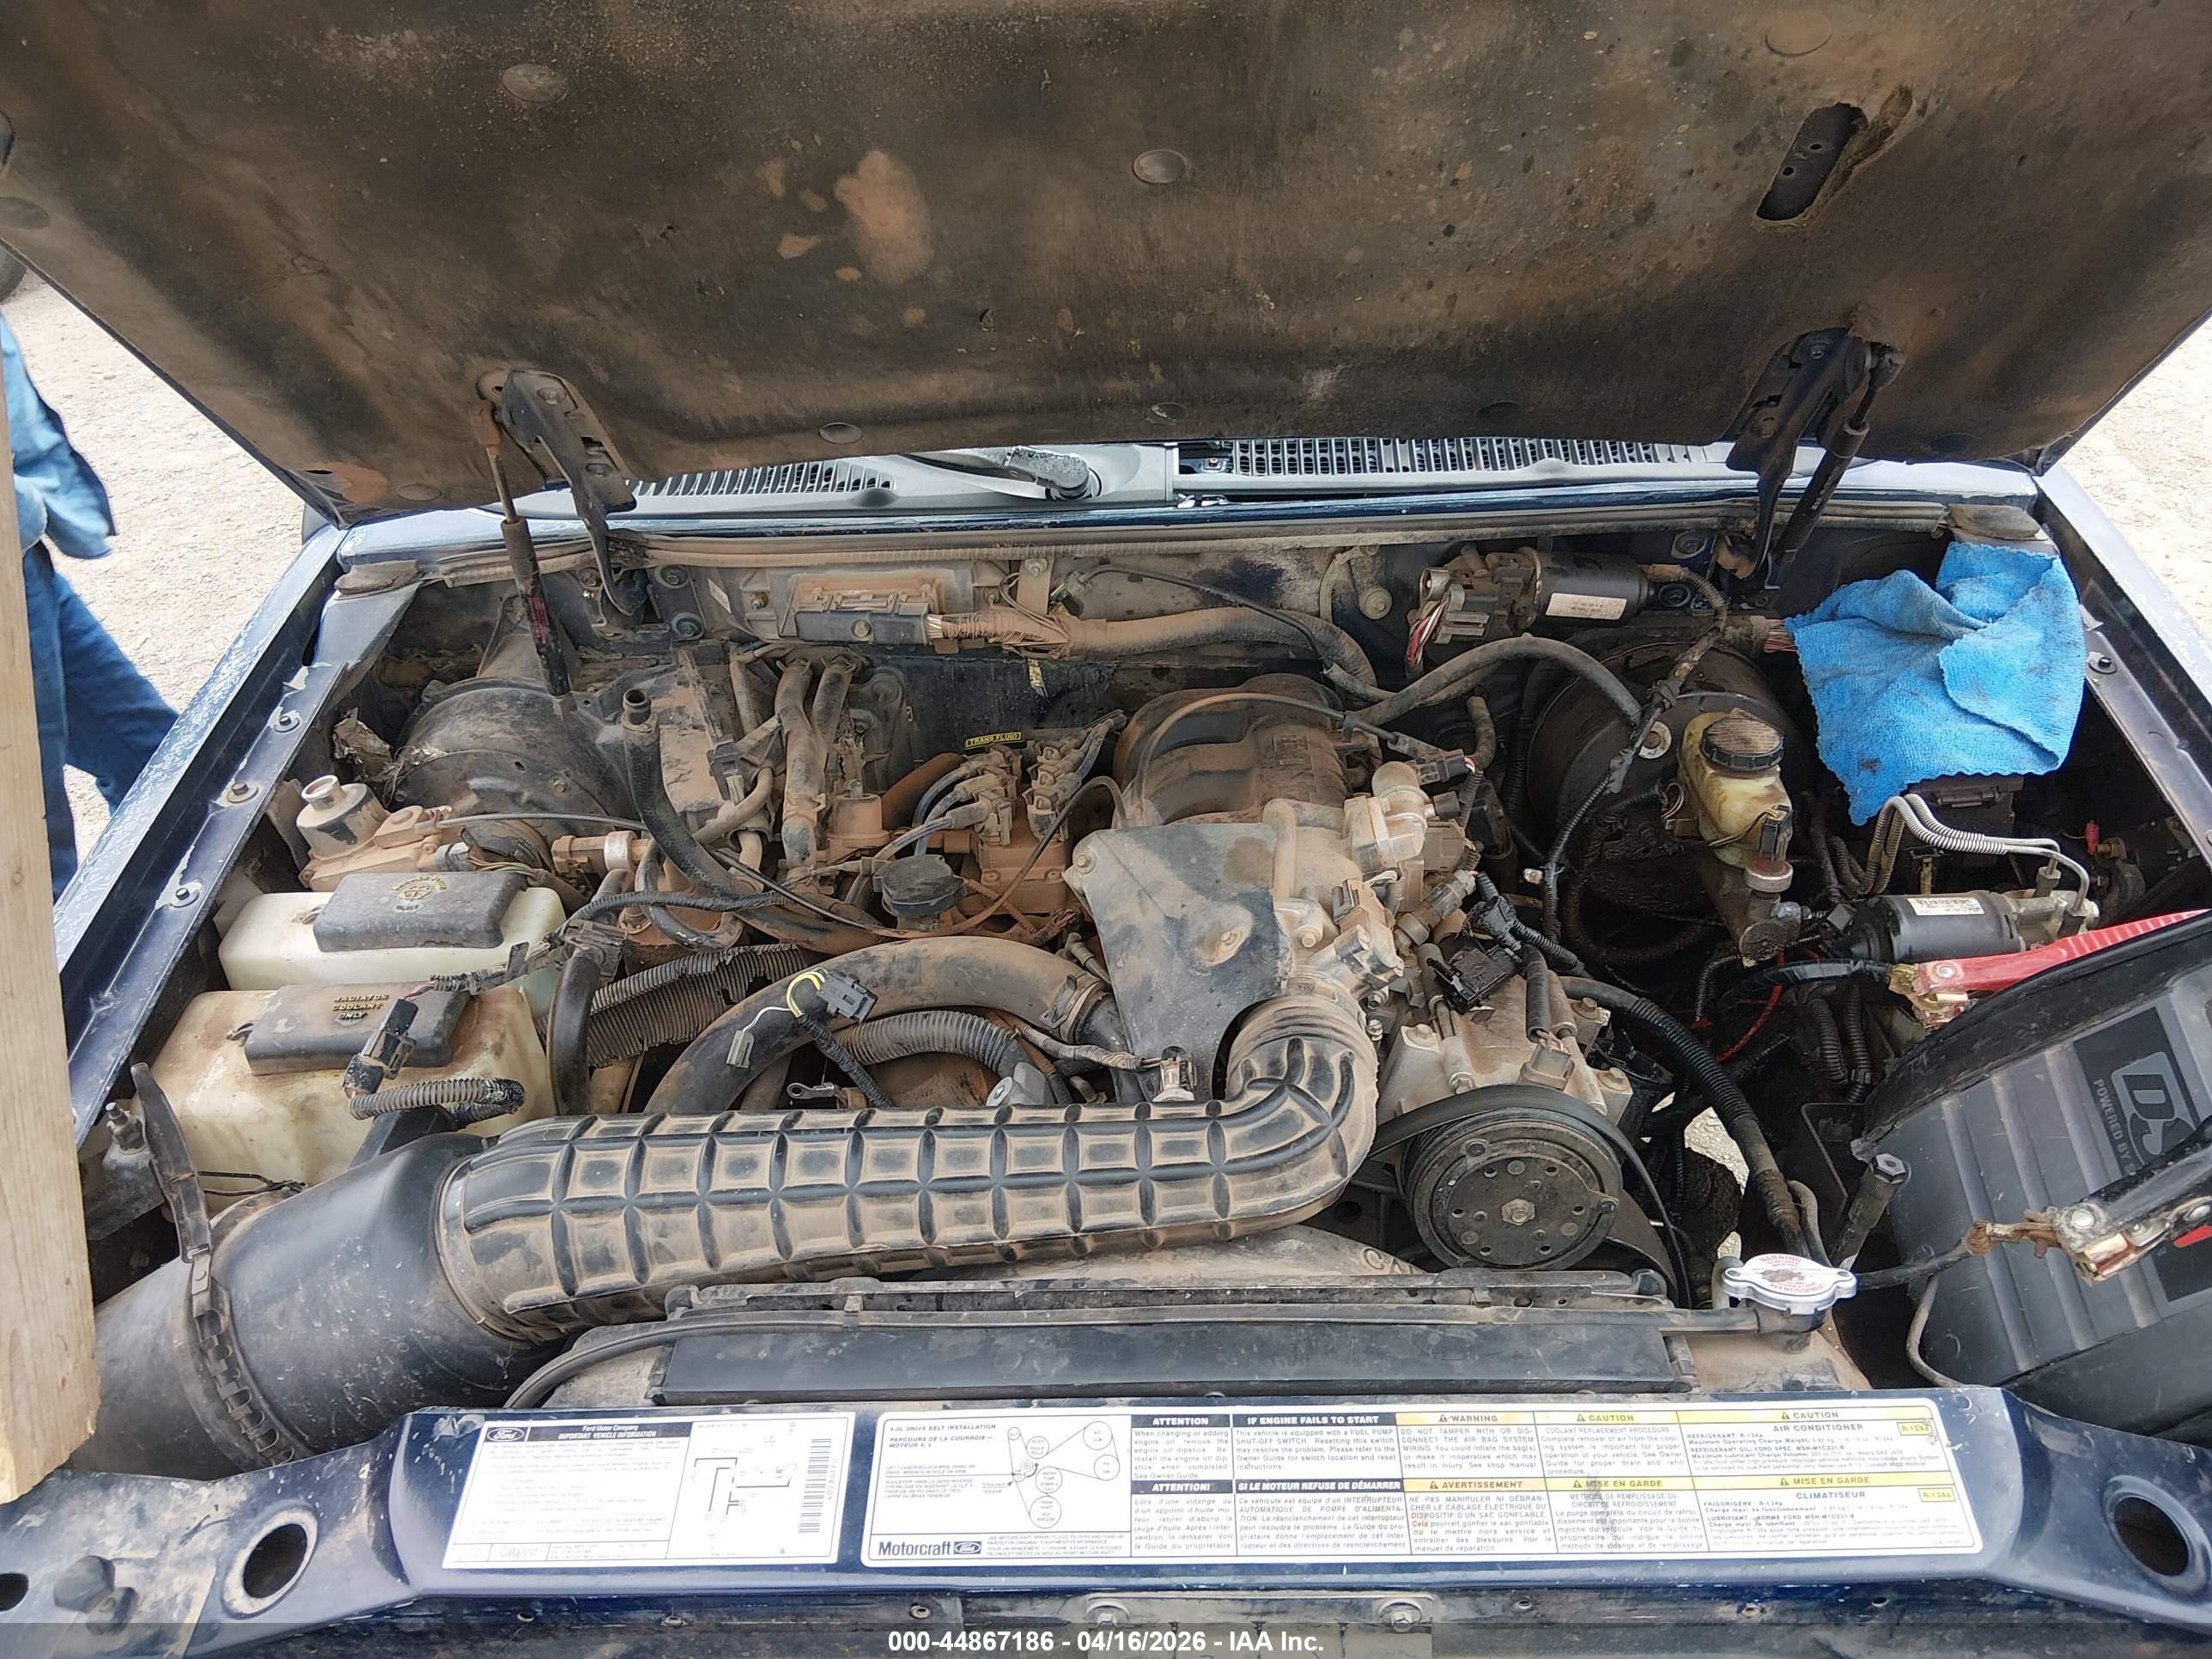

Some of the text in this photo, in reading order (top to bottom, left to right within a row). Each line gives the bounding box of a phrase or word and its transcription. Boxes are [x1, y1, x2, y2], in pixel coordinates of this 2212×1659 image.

[2094, 1079, 2130, 1161] POWERED BY
[493, 1430, 516, 1440] Ford
[1152, 1483, 1210, 1492] ATTENTION!
[1249, 1482, 1260, 1491] LE
[1261, 1482, 1300, 1491] MOTEUR
[1351, 1480, 1401, 1490] DÉMARRER
[878, 1541, 951, 1555] Motorcraft
